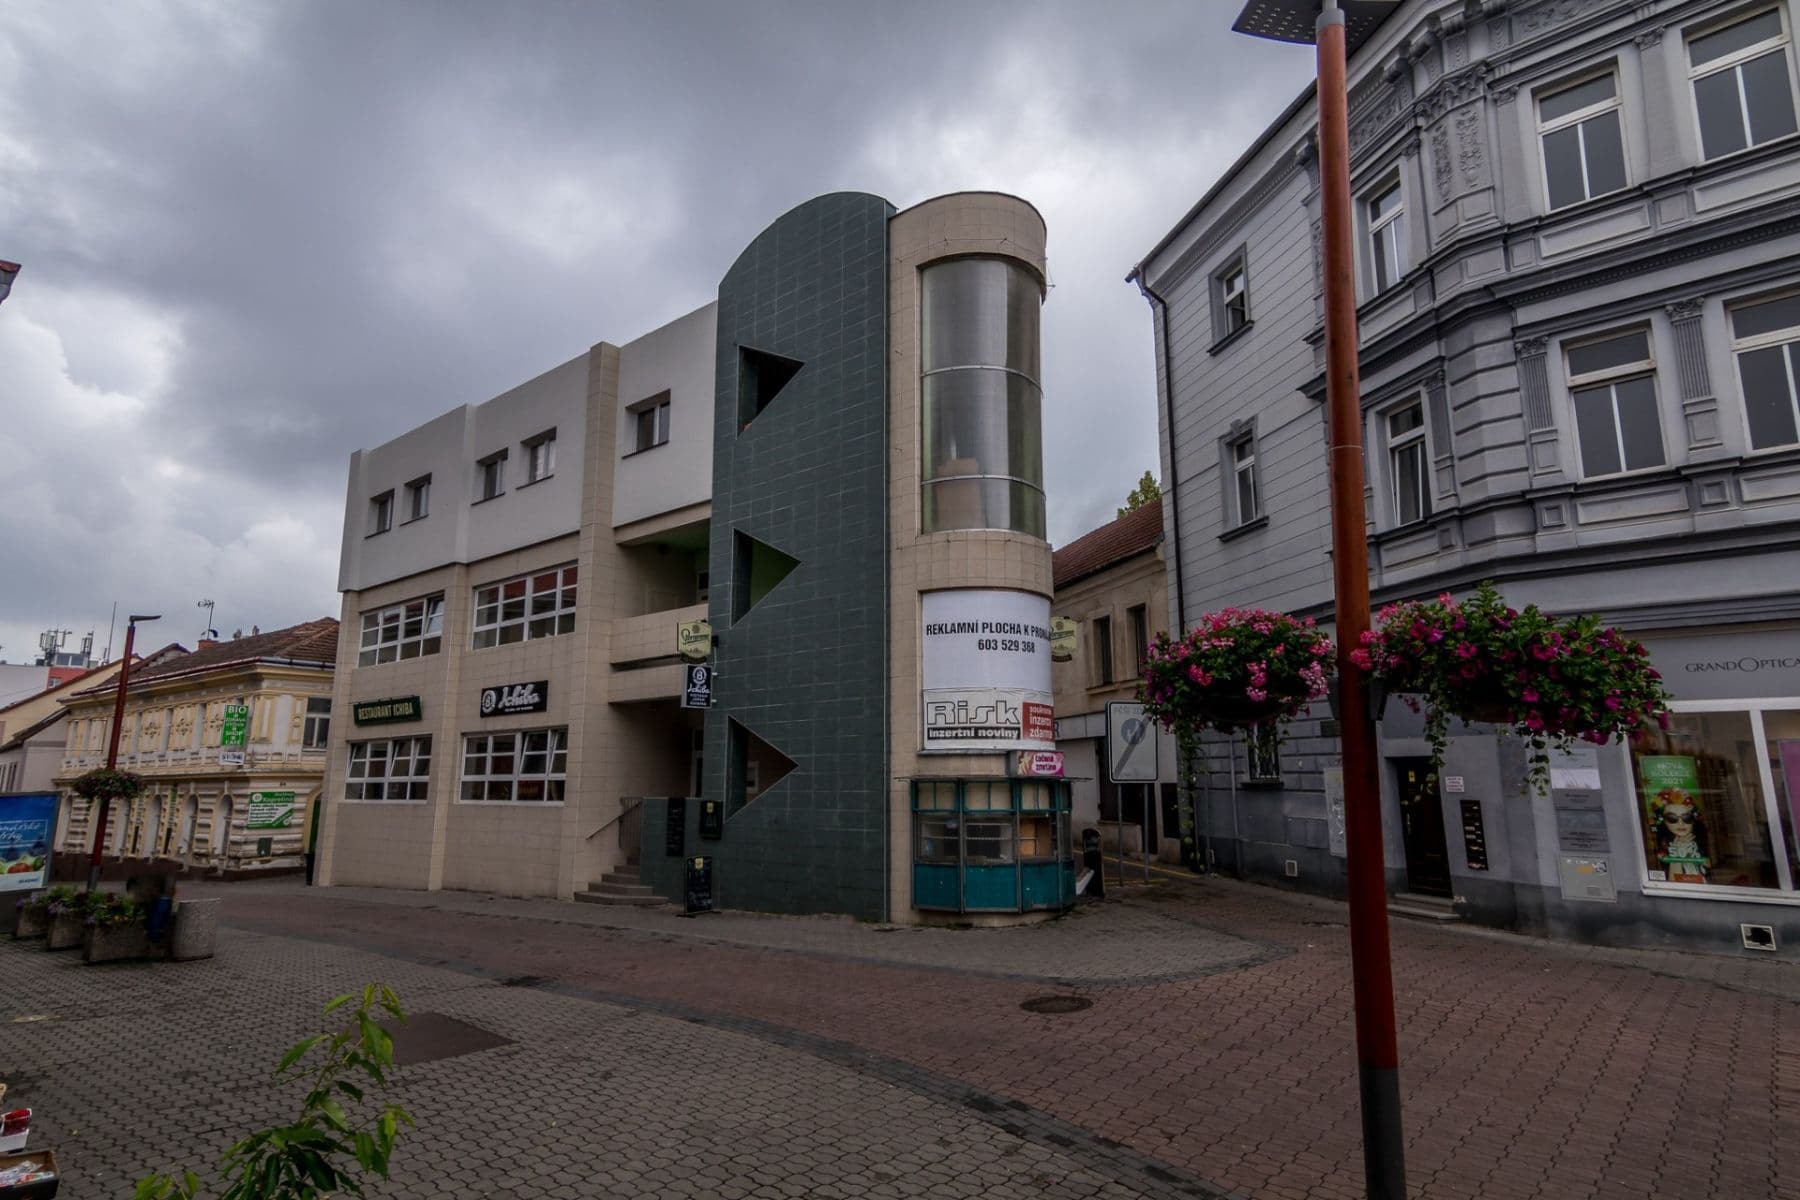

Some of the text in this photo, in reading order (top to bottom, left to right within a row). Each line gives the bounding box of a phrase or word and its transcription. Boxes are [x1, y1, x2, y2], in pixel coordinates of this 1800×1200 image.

[926, 619, 979, 636] REKLAMNÍ
[982, 622, 1021, 636] PLOCHA
[1023, 624, 1030, 637] K
[978, 639, 998, 651] 603
[1001, 640, 1020, 652] 529
[228, 705, 247, 714] BIO
[357, 702, 414, 721] RESTAURANT ICHIBA
[926, 700, 1021, 726] Risk
[929, 727, 1019, 741] inzertní noviny
